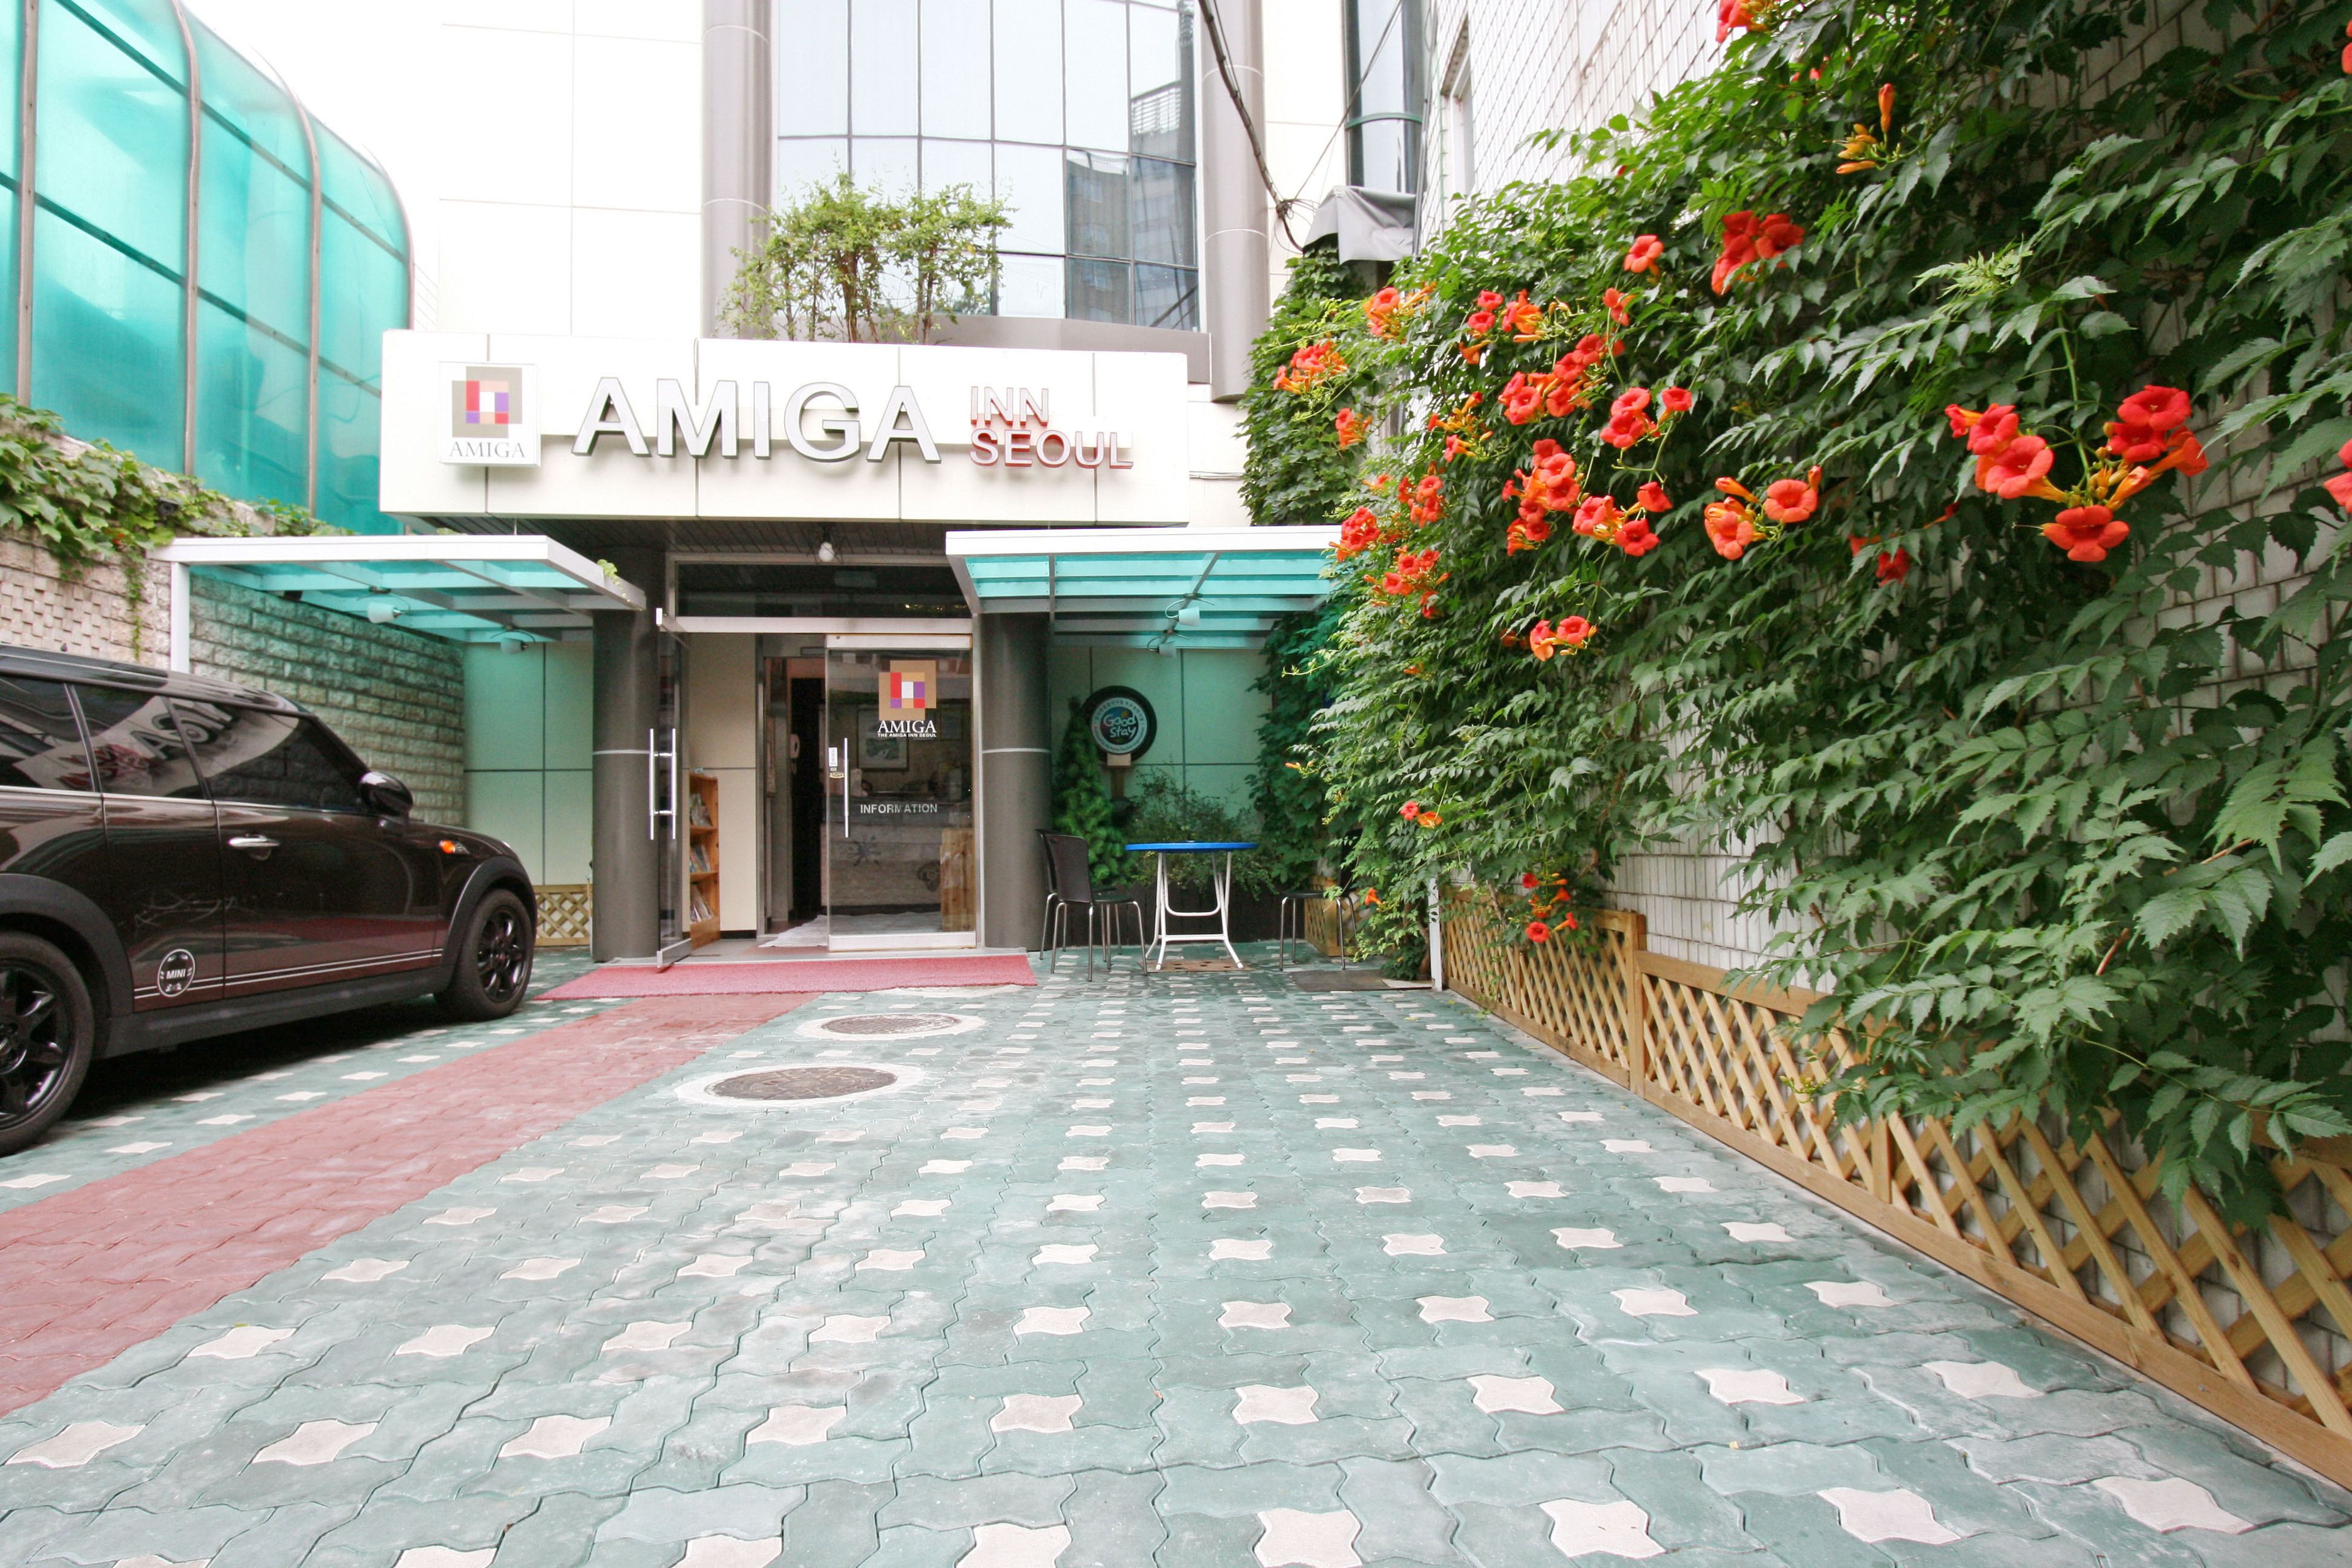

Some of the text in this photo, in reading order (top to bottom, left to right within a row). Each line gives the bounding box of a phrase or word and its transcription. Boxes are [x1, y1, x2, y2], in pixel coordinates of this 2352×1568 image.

[970, 386, 1049, 427] INN
[571, 377, 942, 464] AMIGA
[448, 441, 526, 458] AMIGA
[970, 428, 1133, 470] SEOUL
[877, 720, 937, 733] AMIGA
[1103, 713, 1136, 726] Good
[166, 969, 186, 979] MINI
